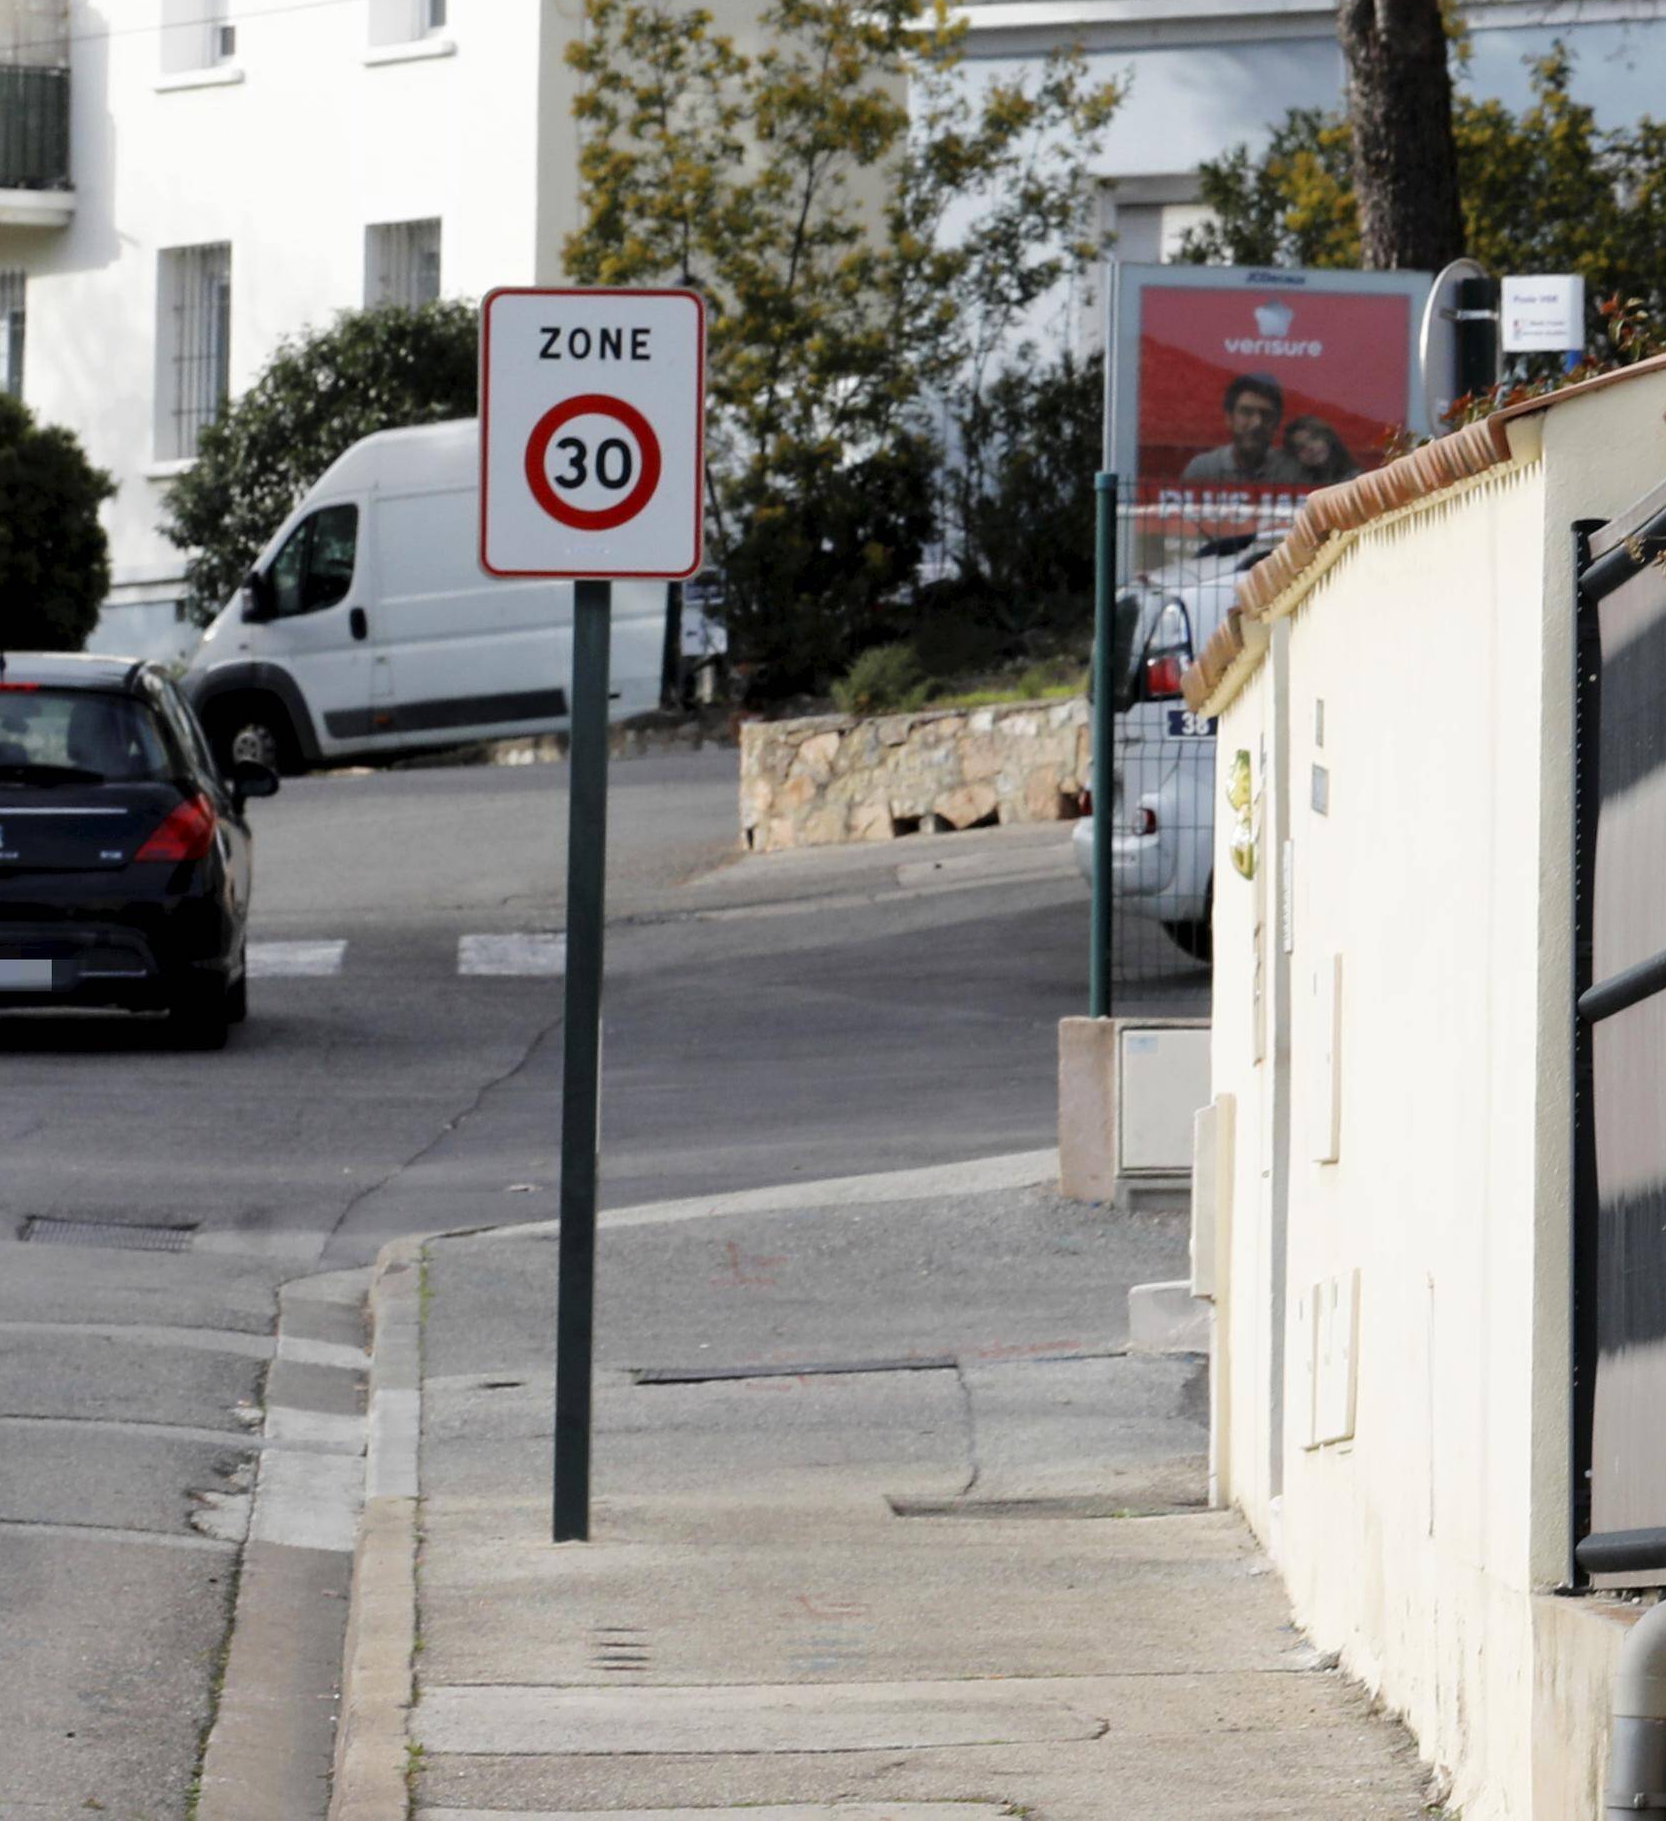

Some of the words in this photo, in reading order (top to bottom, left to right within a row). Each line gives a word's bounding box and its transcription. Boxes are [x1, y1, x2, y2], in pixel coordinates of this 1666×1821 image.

[539, 327, 651, 361] ZONE
[1224, 338, 1323, 357] verisure
[554, 436, 632, 490] 30
